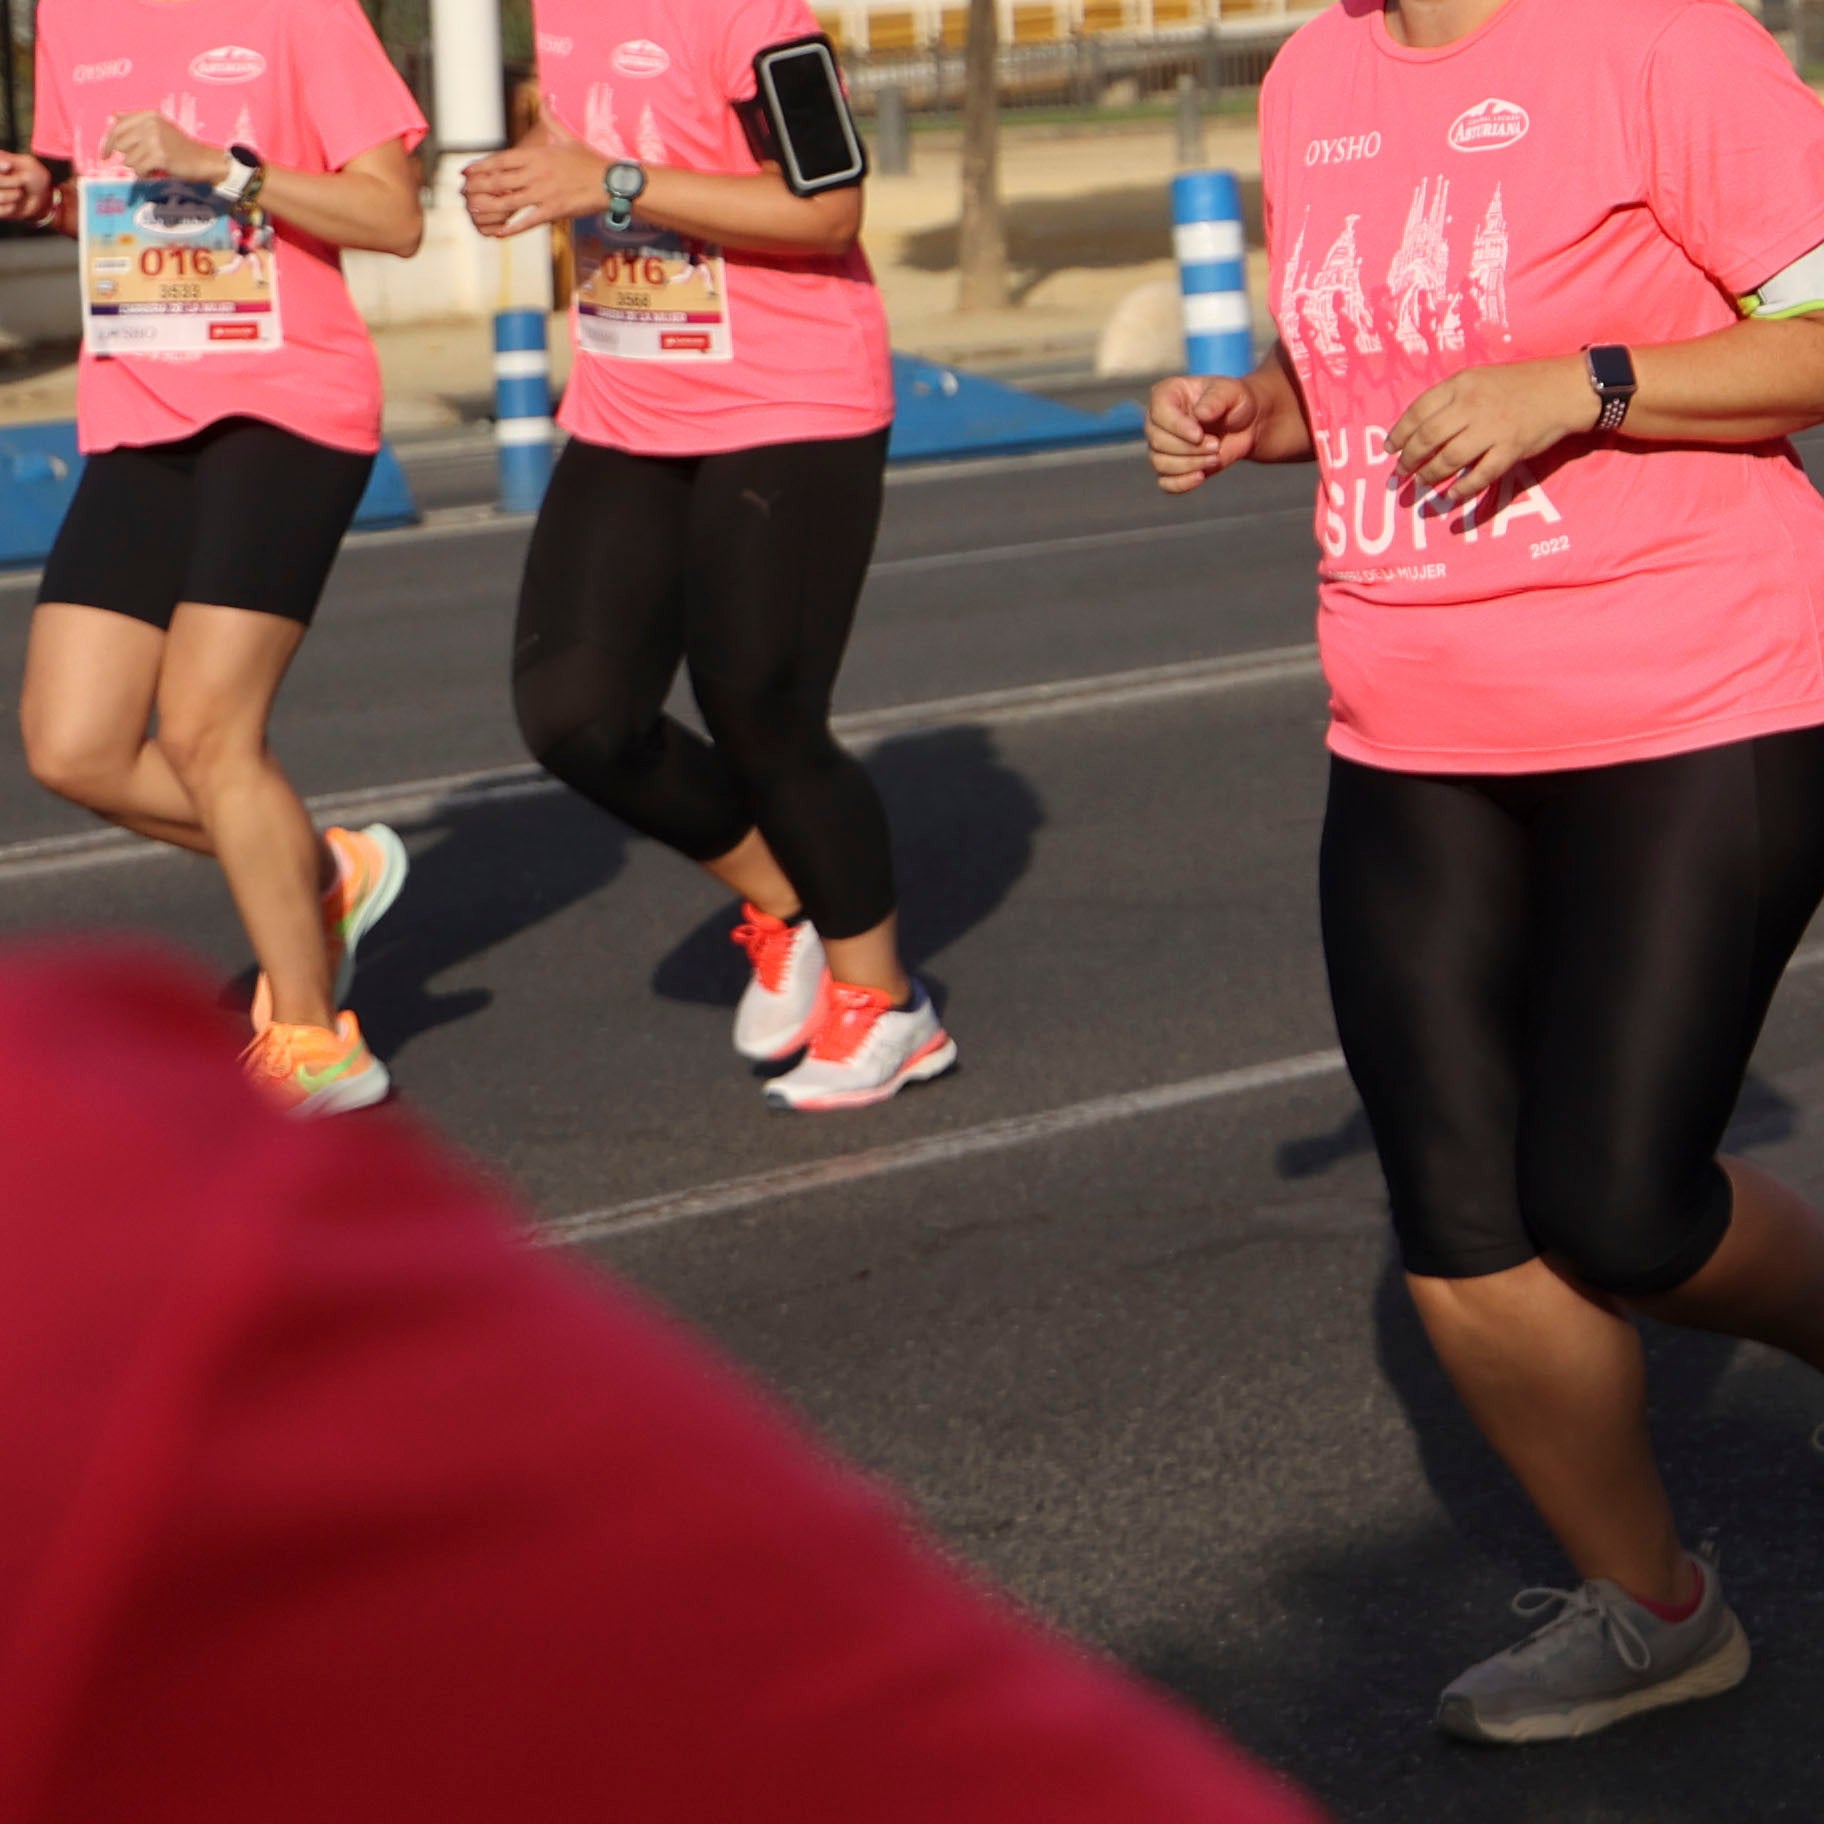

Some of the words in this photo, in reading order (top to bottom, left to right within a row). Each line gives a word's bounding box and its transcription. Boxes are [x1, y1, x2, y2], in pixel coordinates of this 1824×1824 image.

[1453, 118, 1521, 144] ASTURIANA
[1305, 131, 1382, 167] OYSHO
[139, 246, 214, 277] 016
[604, 256, 665, 286] 016
[1530, 535, 1571, 560] 2022
[1396, 562, 1446, 580] MUJER
